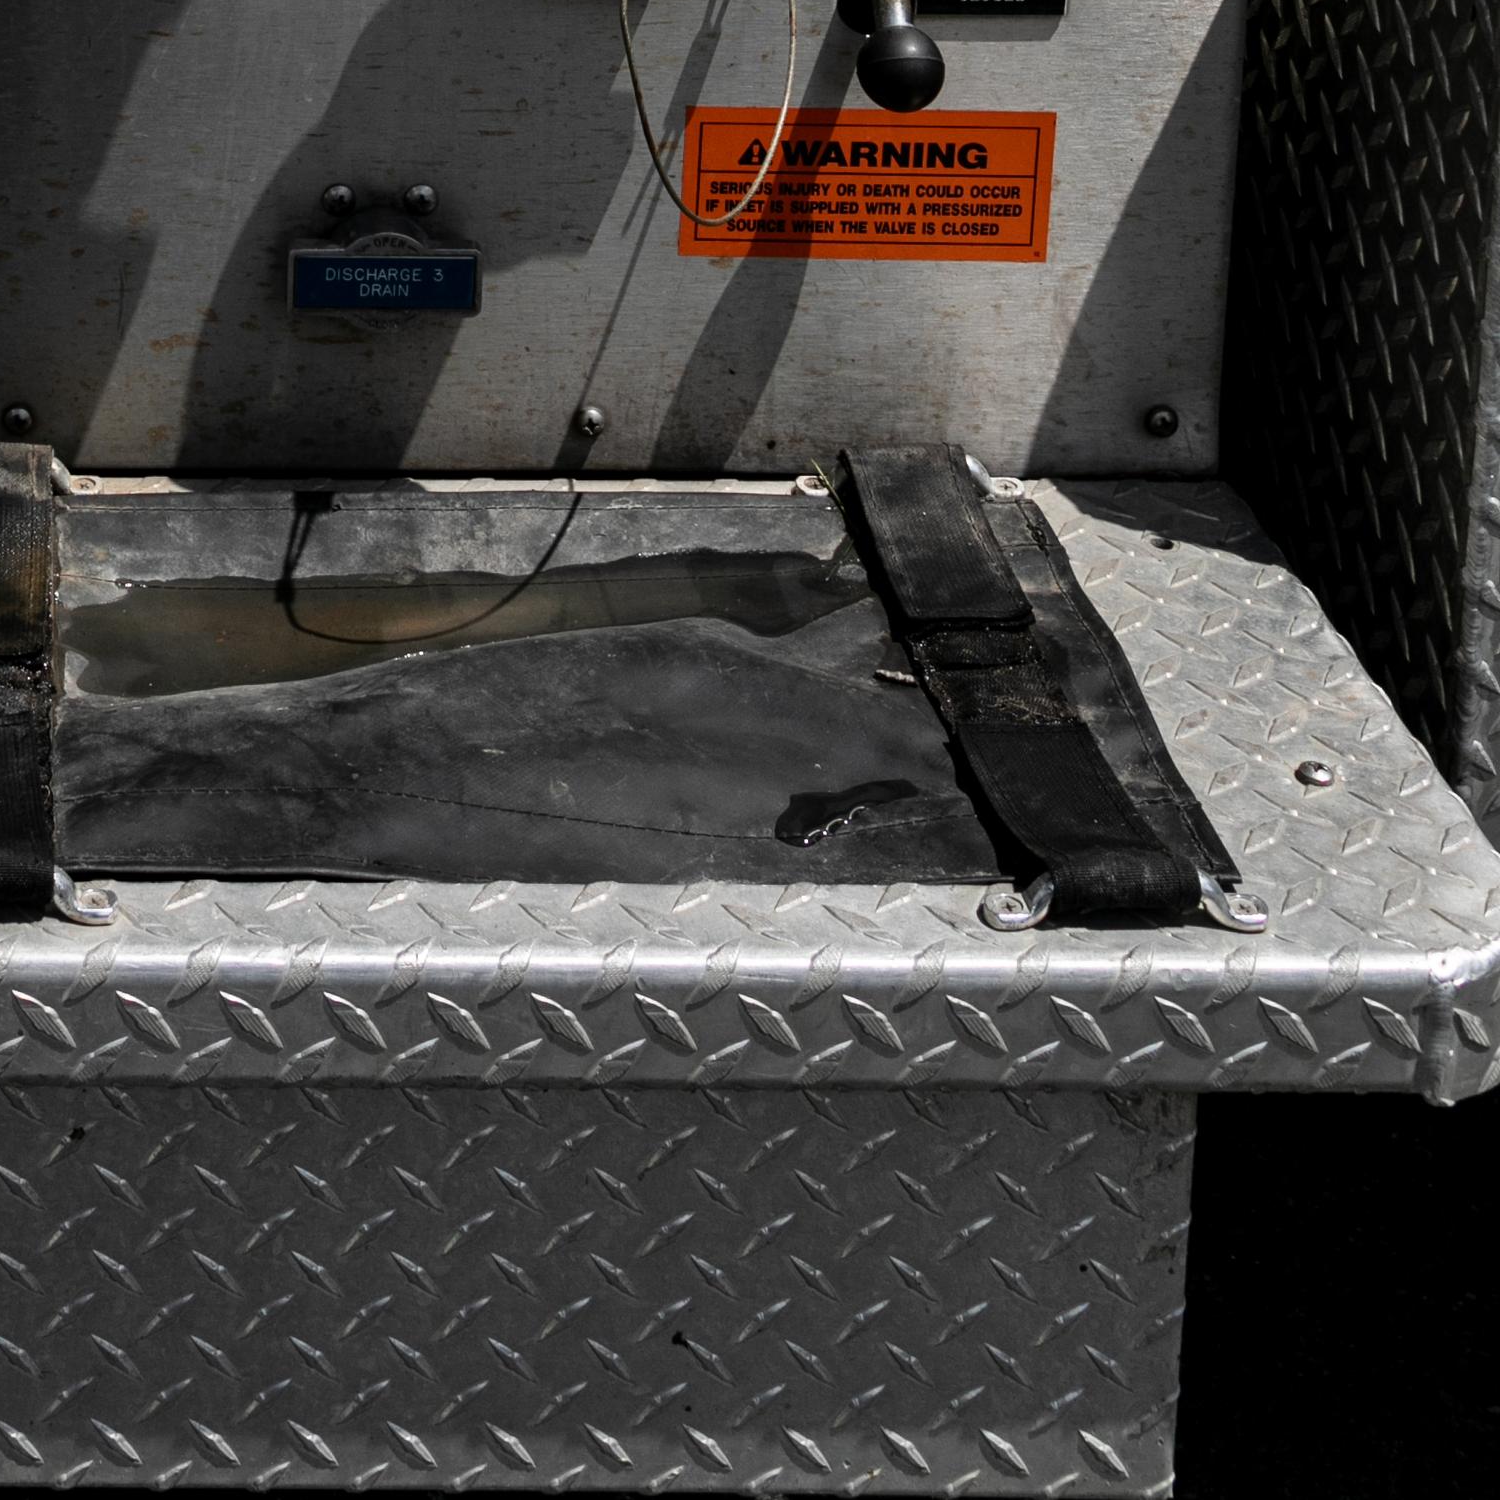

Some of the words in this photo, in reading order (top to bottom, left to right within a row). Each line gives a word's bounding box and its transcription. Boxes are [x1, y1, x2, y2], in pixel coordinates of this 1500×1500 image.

[781, 139, 989, 169] WARNING
[779, 182, 831, 196] INJURY
[836, 183, 857, 197] OR
[863, 184, 910, 197] DEATH
[915, 184, 964, 198] COULD
[970, 186, 1021, 199] OCCUR
[705, 199, 720, 212] IF
[769, 200, 784, 213] IS
[790, 200, 859, 214] SUPPLIED
[865, 202, 901, 215] WITH
[906, 202, 917, 215] A
[922, 203, 1023, 217] PRESSURIZED
[726, 218, 786, 232] SOURCE
[791, 219, 834, 233] WHEN
[840, 221, 868, 234] THE
[874, 221, 917, 235] VALVE
[921, 222, 936, 235] IS
[941, 222, 1000, 236] CLOSED
[373, 236, 407, 248] OPEN
[325, 267, 422, 282] DISCHARGE
[433, 268, 444, 282] 3
[359, 283, 410, 297] DRAIN
